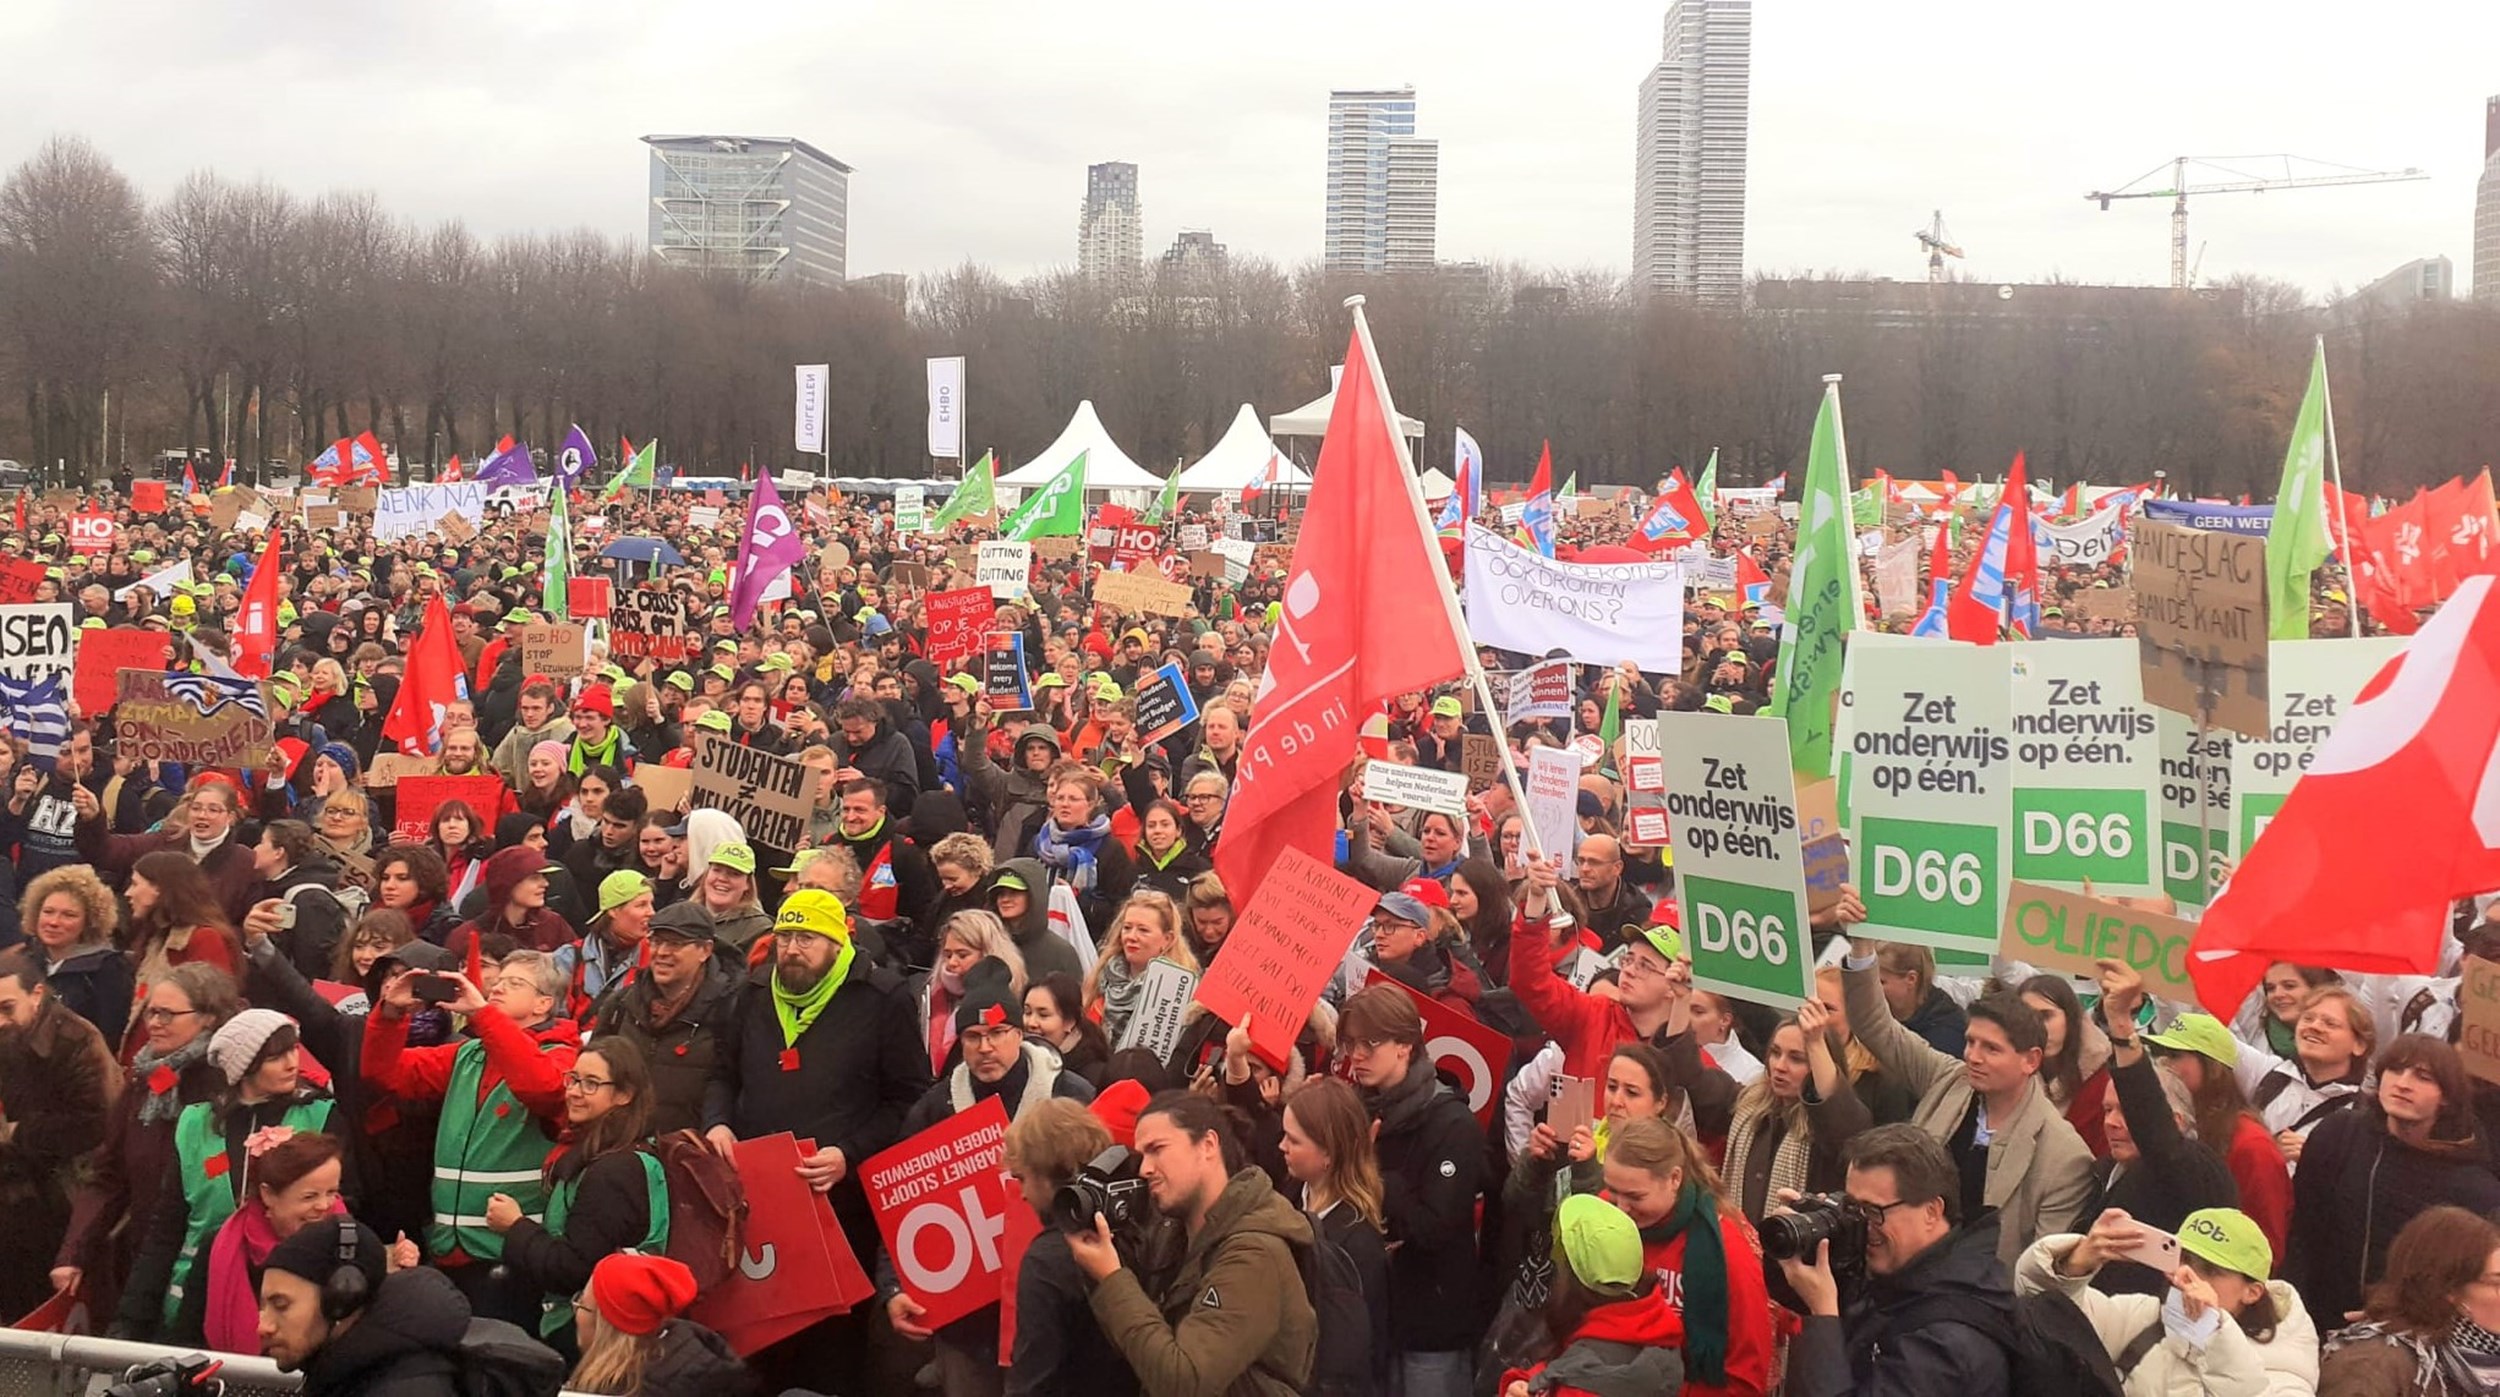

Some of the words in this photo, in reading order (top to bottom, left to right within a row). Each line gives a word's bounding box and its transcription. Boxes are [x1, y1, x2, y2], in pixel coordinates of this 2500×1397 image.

[443, 483, 481, 507] NA
[71, 517, 113, 538] HO
[2194, 515, 2234, 529] GEEN
[980, 547, 1023, 560] CUTTING
[1120, 528, 1156, 551] HO
[979, 567, 1024, 583] GUTTING
[615, 588, 633, 608] DE
[637, 590, 679, 616] CRISIS
[527, 632, 545, 644] RED
[549, 629, 572, 645] HO
[932, 619, 952, 635] OP
[955, 616, 970, 632] JE
[525, 650, 553, 660] STOP
[988, 662, 1018, 672] welcome
[996, 651, 1008, 659] We
[992, 674, 1013, 684] every
[2047, 678, 2102, 706] Zet
[1149, 699, 1177, 717] Budget
[1903, 691, 1957, 725] Zet
[2284, 692, 2337, 718] Zet
[2013, 707, 2156, 742] nderwijs
[119, 717, 268, 763] MONDIGHEID
[1853, 725, 2009, 769] onderwijs
[2018, 742, 2058, 770] op
[2064, 736, 2133, 764] één.
[701, 736, 807, 800] STUDENTEN
[1369, 763, 1389, 774] Onze
[1390, 768, 1449, 786] universiteiten
[1702, 757, 1748, 791] Zet
[1873, 764, 1912, 798] op
[1917, 759, 1986, 795] één.
[2253, 752, 2292, 777] op
[1385, 777, 1414, 792] helpen
[1414, 783, 1458, 798] Nederland
[1401, 791, 1433, 805] vooruit
[2162, 781, 2197, 809] op
[1667, 790, 1796, 835] onderwijs
[1687, 826, 1719, 859] op
[1723, 821, 1781, 861] één.
[2023, 810, 2133, 859] D66
[1873, 844, 1983, 907] D66
[1696, 902, 1789, 966] D66
[1174, 975, 1190, 1005] Onze
[1152, 998, 1171, 1039] helpen
[954, 1121, 1004, 1156] HOGER
[871, 1143, 952, 1191] ONDERWIJS
[880, 1171, 940, 1212] SLOOPT
